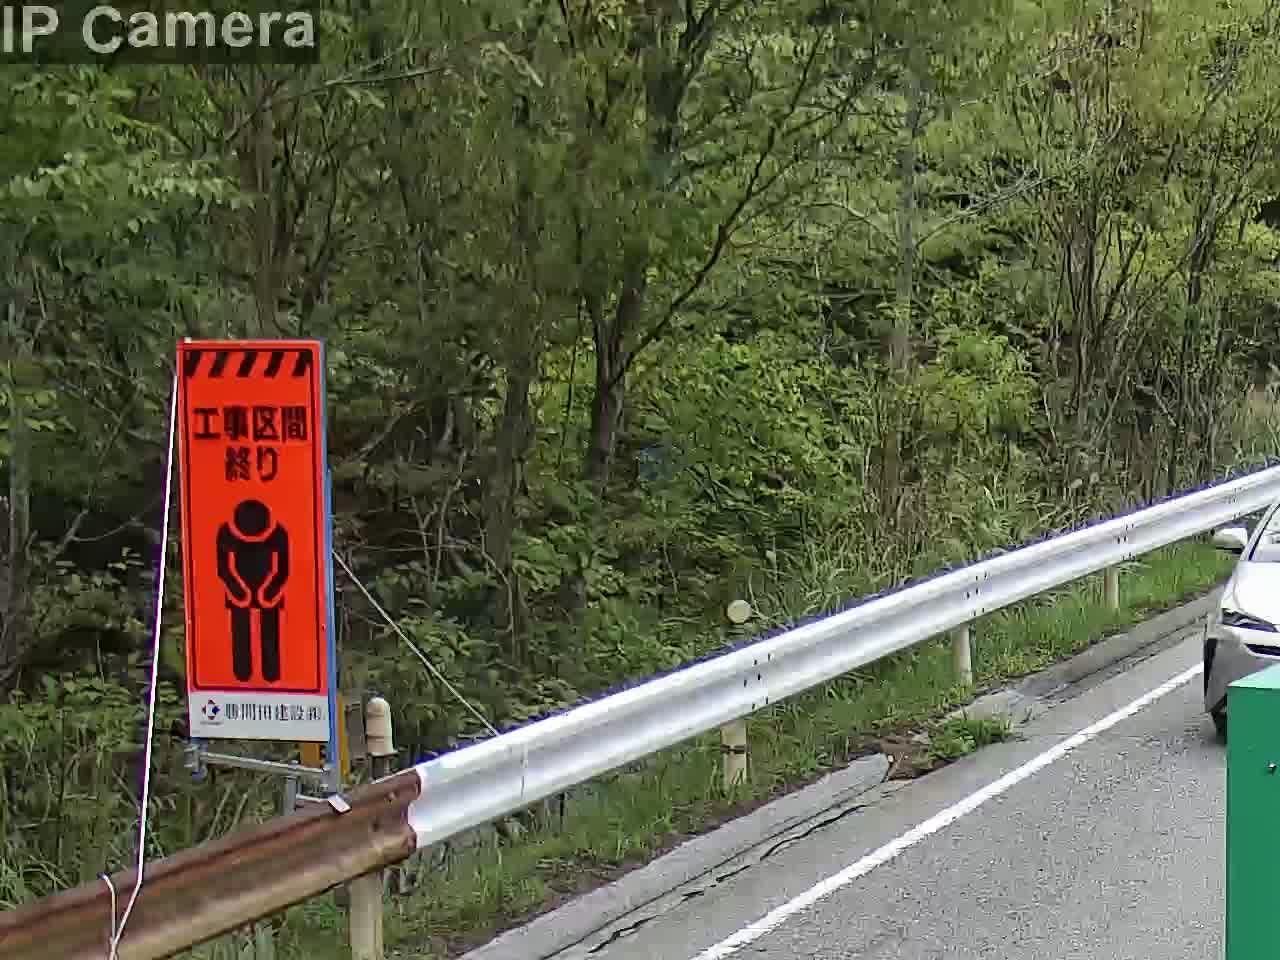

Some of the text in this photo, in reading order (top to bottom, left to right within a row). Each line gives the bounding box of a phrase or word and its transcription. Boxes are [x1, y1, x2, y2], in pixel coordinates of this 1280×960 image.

[192, 404, 308, 443] 工事区間
[225, 446, 279, 482] 終り
